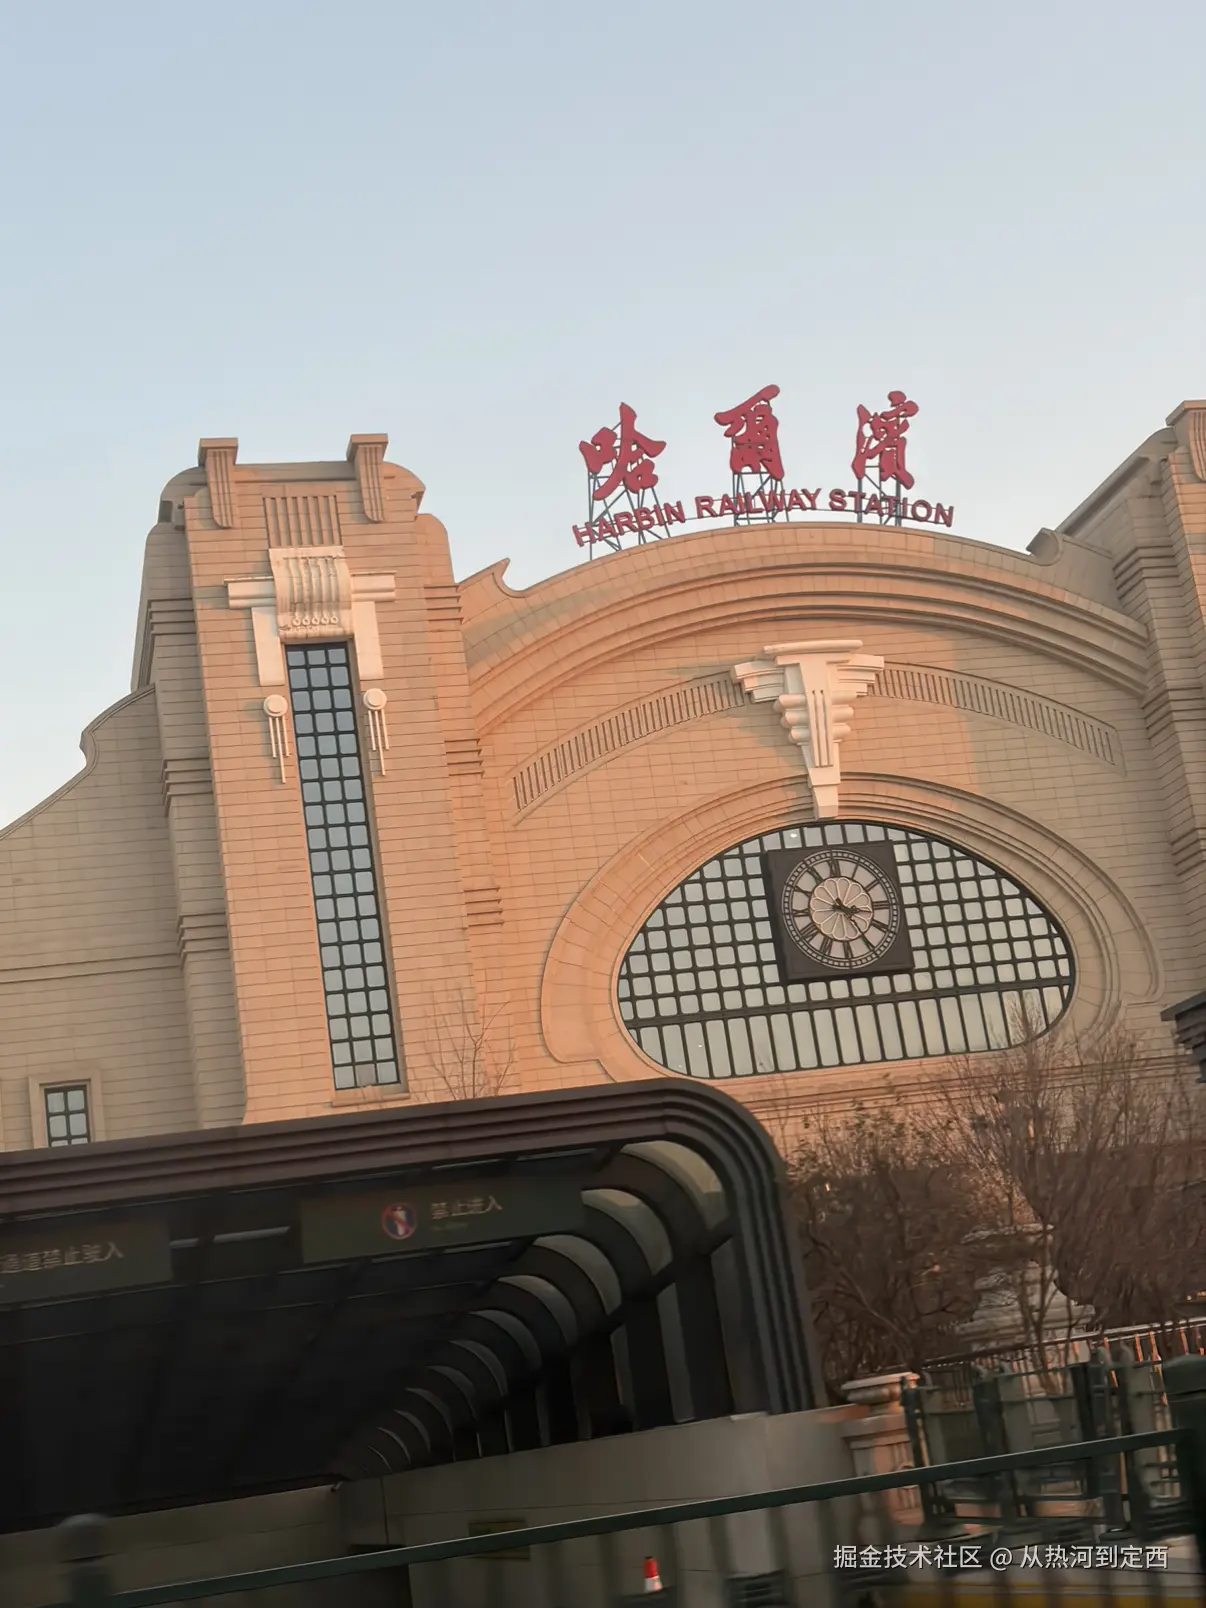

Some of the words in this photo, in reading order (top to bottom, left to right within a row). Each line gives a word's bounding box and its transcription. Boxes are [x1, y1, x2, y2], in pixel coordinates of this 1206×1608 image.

[572, 500, 686, 547] HARBIN
[695, 487, 822, 519] RAILWAY
[828, 489, 954, 528] STATION
